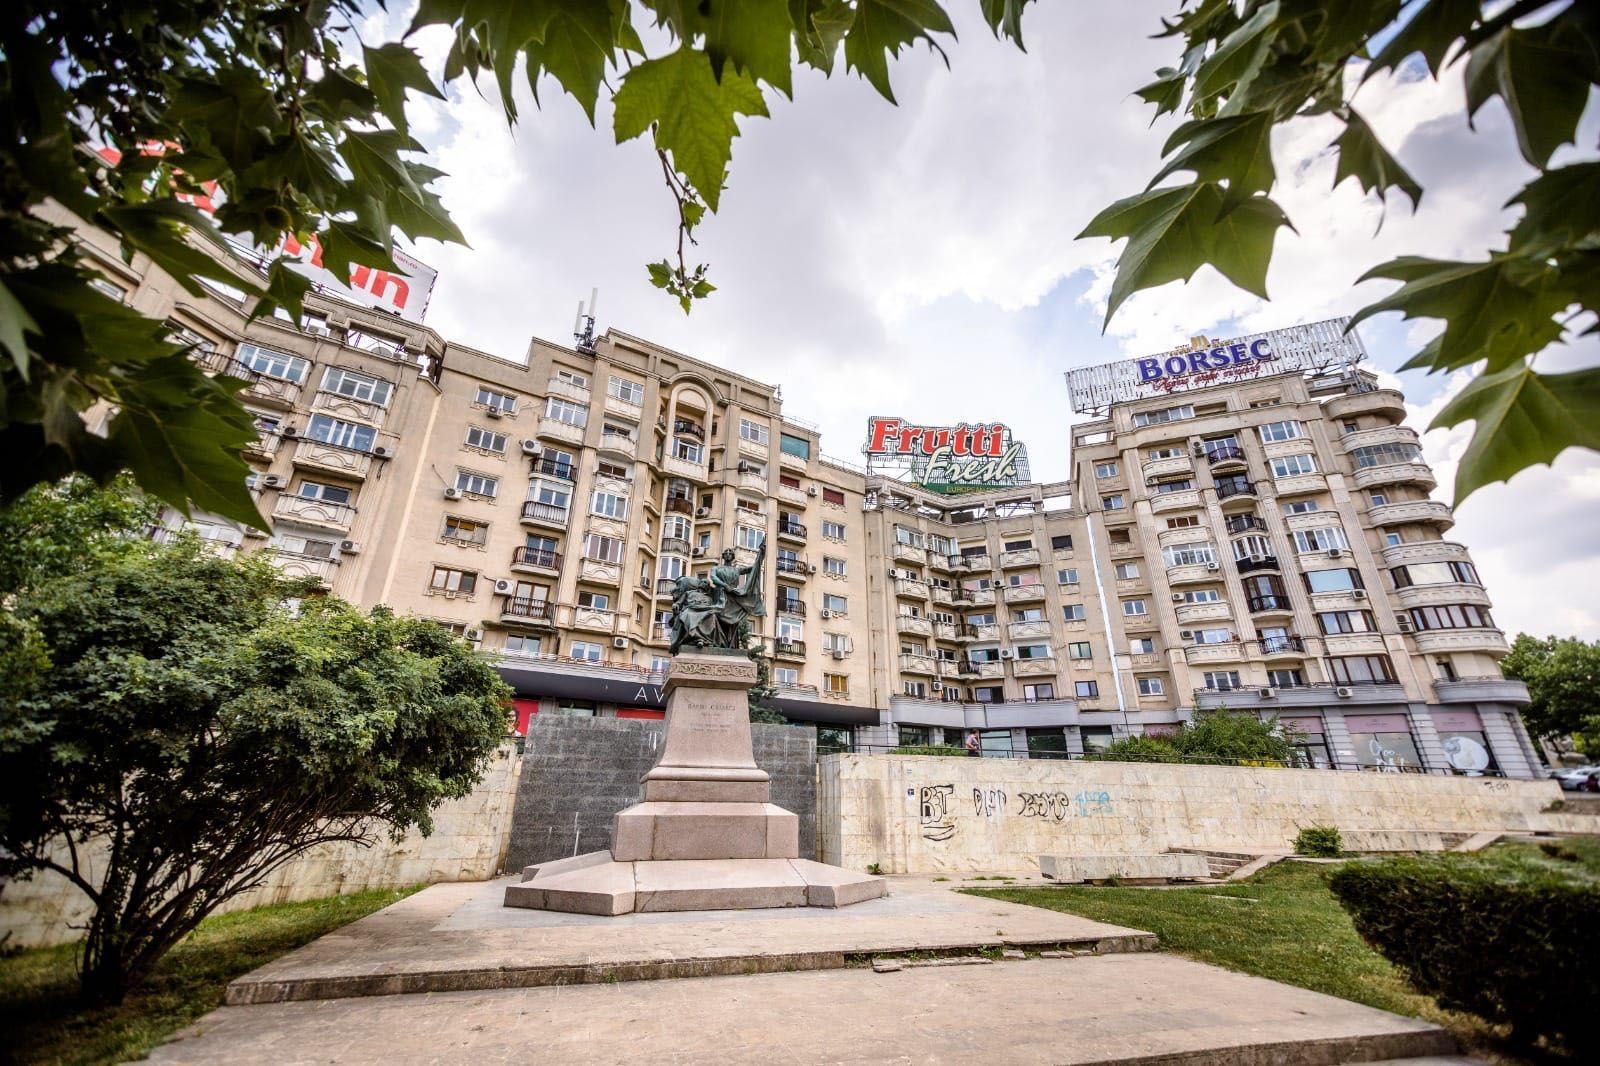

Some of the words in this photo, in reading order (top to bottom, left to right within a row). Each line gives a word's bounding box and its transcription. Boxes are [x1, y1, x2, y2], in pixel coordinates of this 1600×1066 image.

[1137, 338, 1272, 381] BORSEC
[867, 418, 1004, 457] Frutti
[922, 441, 1022, 486] Fresh
